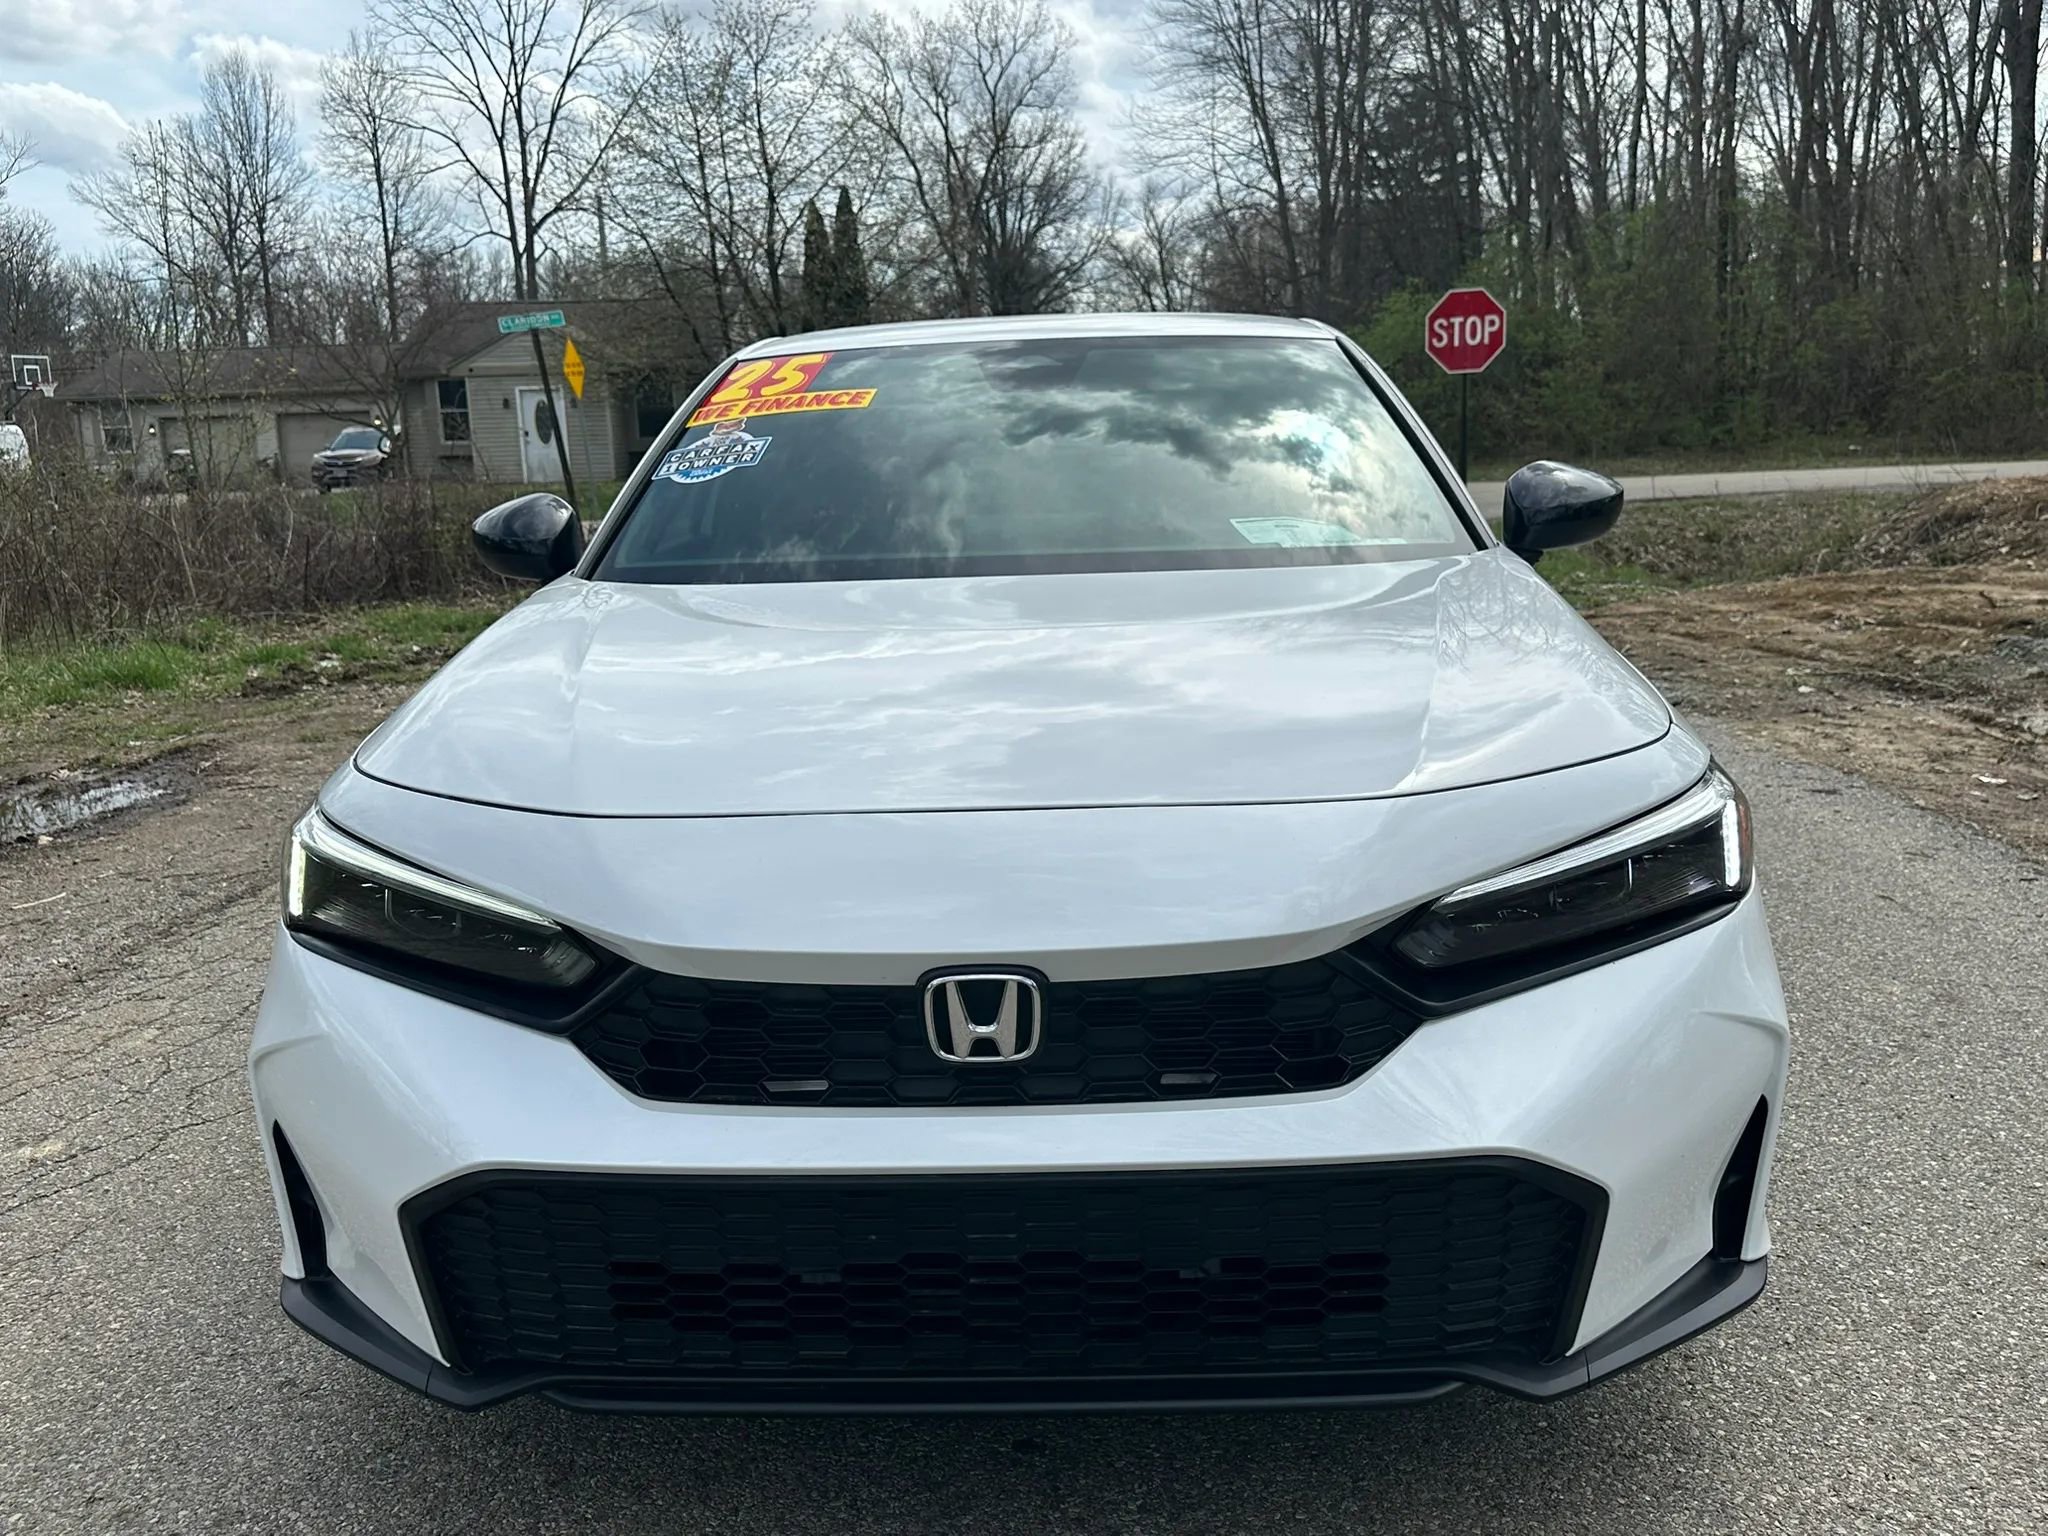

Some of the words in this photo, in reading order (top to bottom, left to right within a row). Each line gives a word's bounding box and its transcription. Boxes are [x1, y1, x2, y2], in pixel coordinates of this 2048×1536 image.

[1432, 314, 1500, 348] STOP
[710, 353, 827, 404] 25
[694, 402, 735, 422] WE
[739, 390, 873, 416] FINANCE
[670, 443, 760, 462] CARFAX
[678, 453, 754, 471] OWNER
